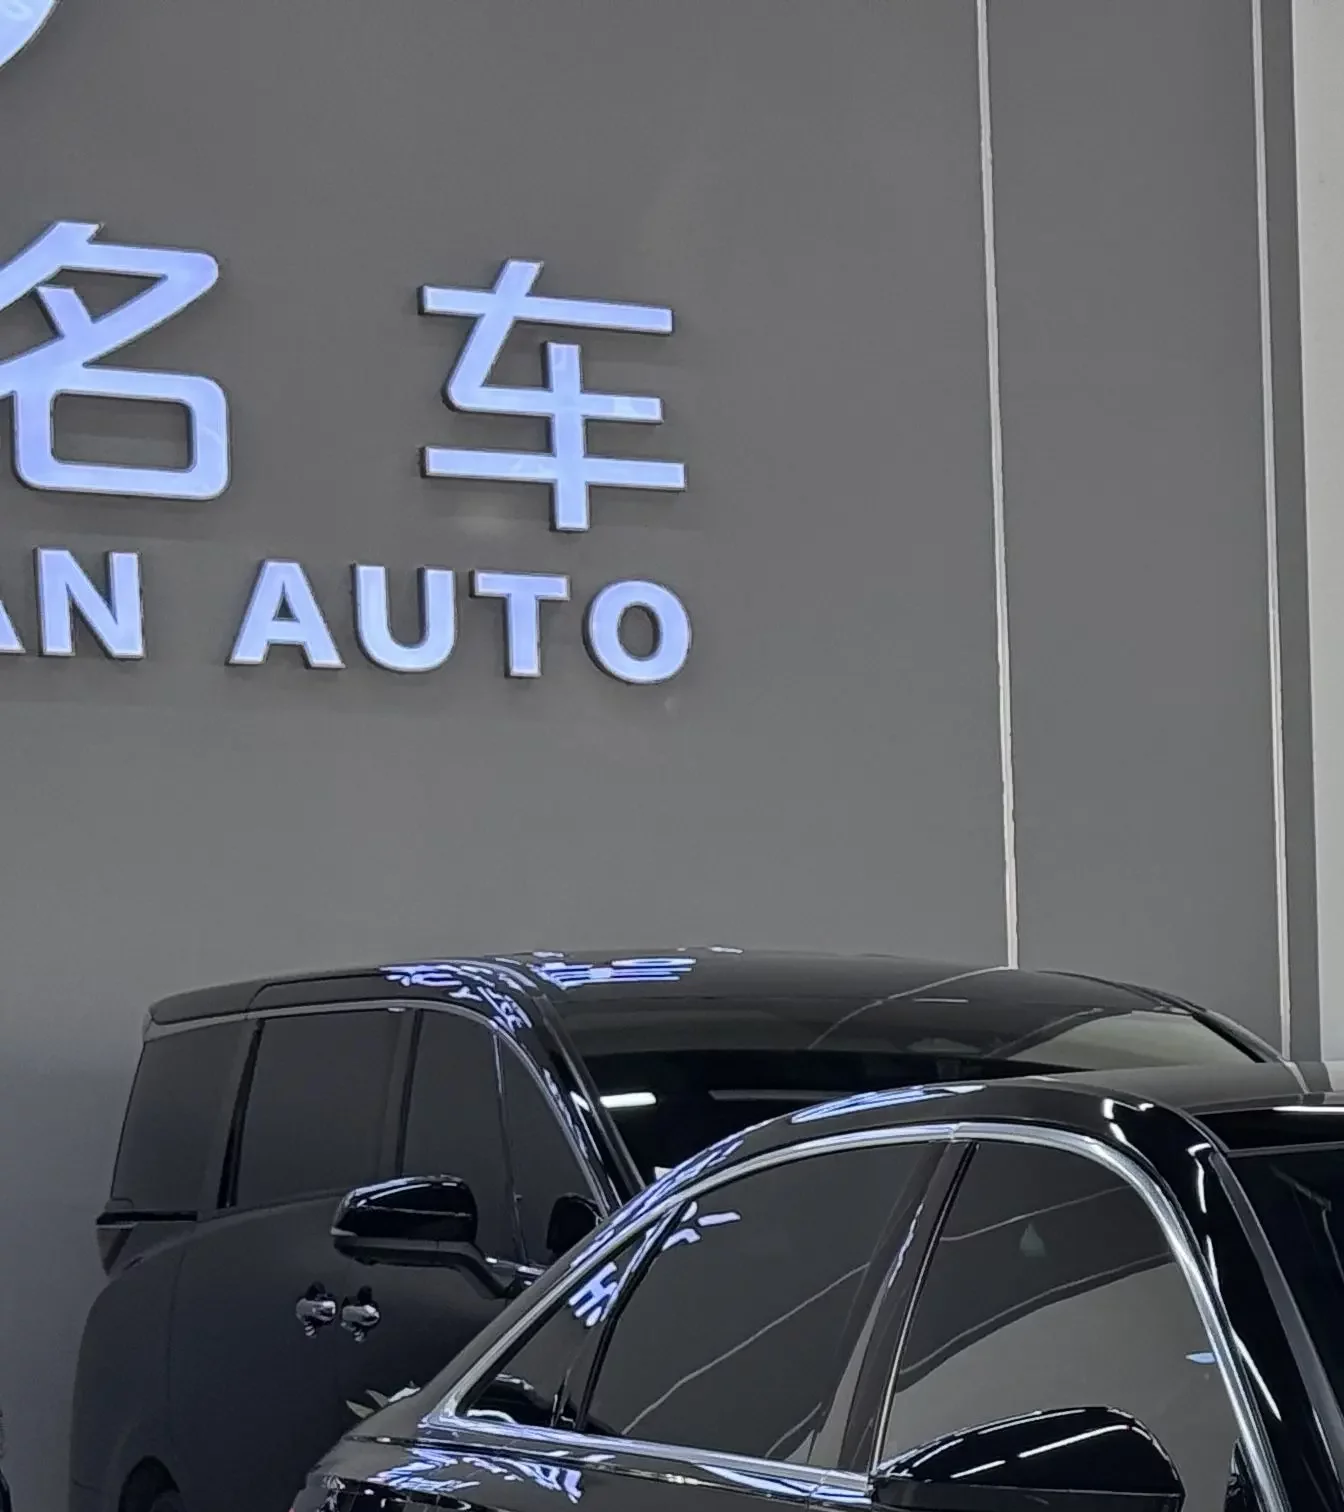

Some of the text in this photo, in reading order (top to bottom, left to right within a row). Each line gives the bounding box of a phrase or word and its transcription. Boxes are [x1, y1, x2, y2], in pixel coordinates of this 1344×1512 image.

[0, 222, 685, 532] 名车
[0, 547, 692, 685] N AUTO
